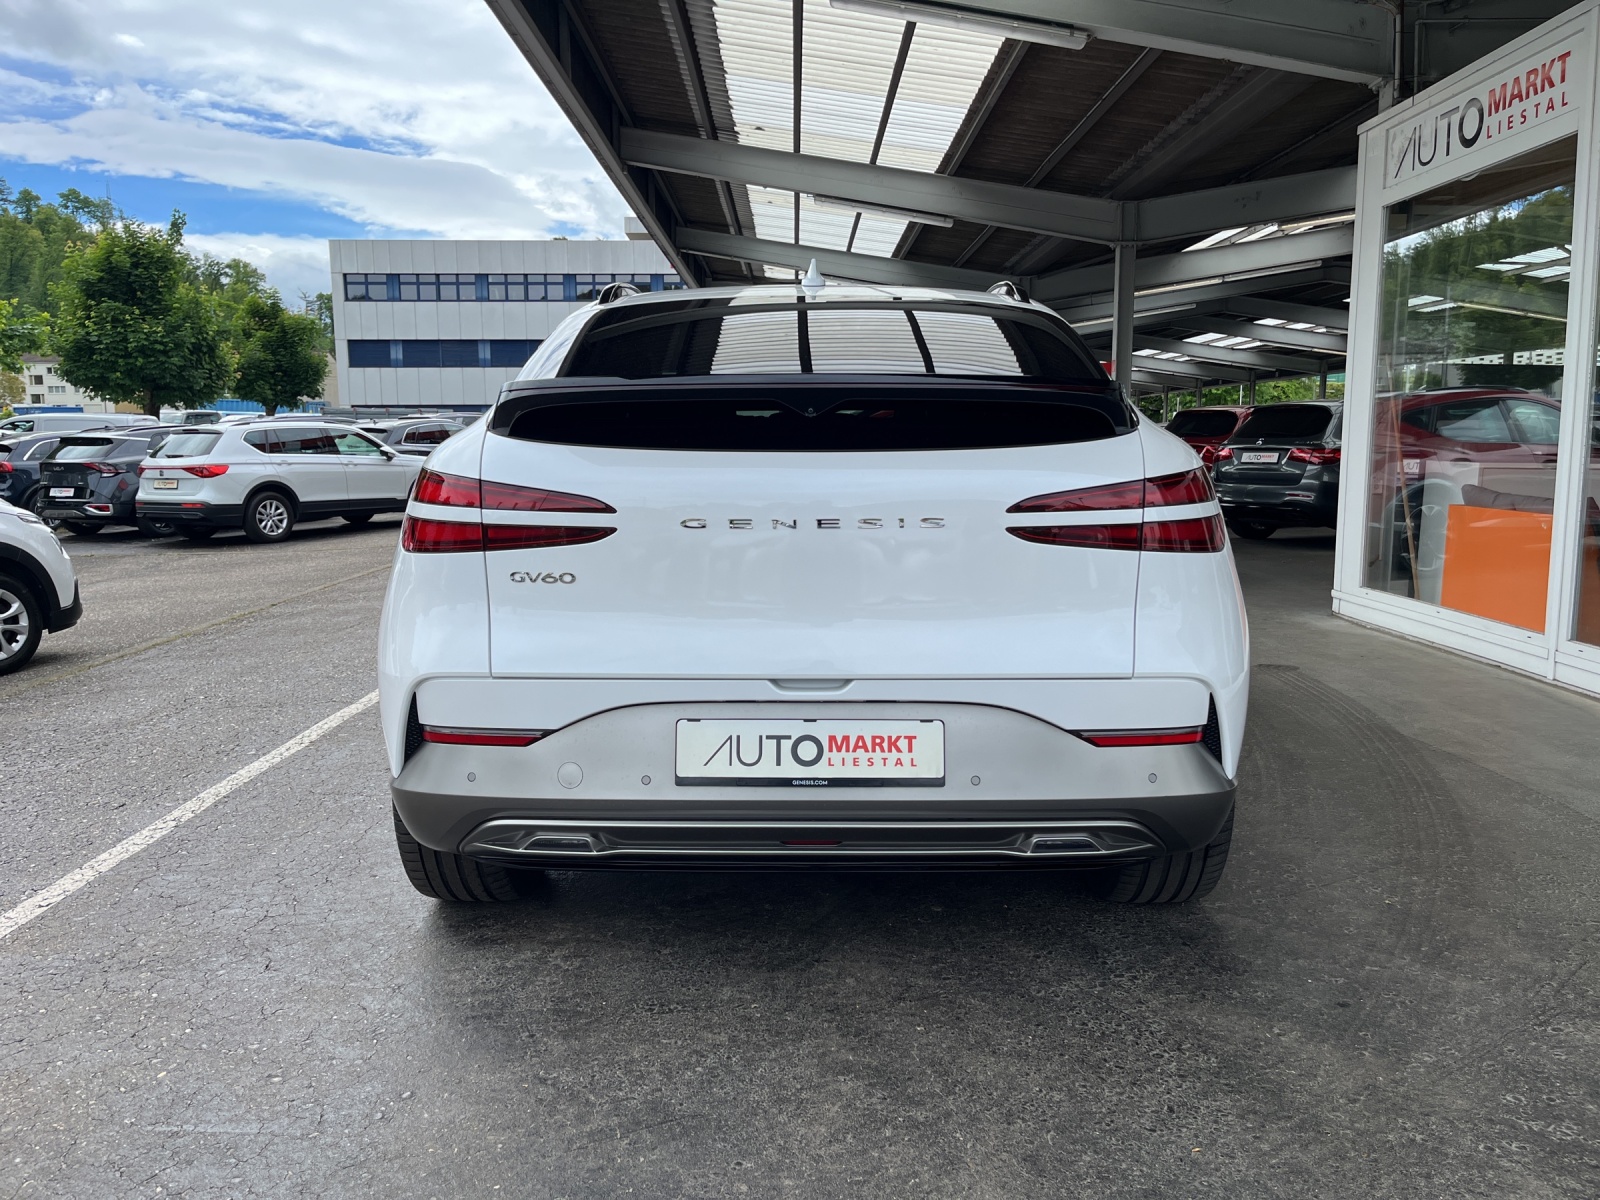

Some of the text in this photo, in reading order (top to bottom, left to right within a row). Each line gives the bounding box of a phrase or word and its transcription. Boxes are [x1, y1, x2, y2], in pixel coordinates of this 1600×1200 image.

[1394, 50, 1572, 179] AUTO MARKT
[1486, 91, 1569, 140] LIESTAL
[680, 517, 946, 530] GENESIS
[509, 571, 577, 584] GV60
[703, 734, 918, 768] AUTO MARKT
[827, 757, 918, 767] LIESTAL
